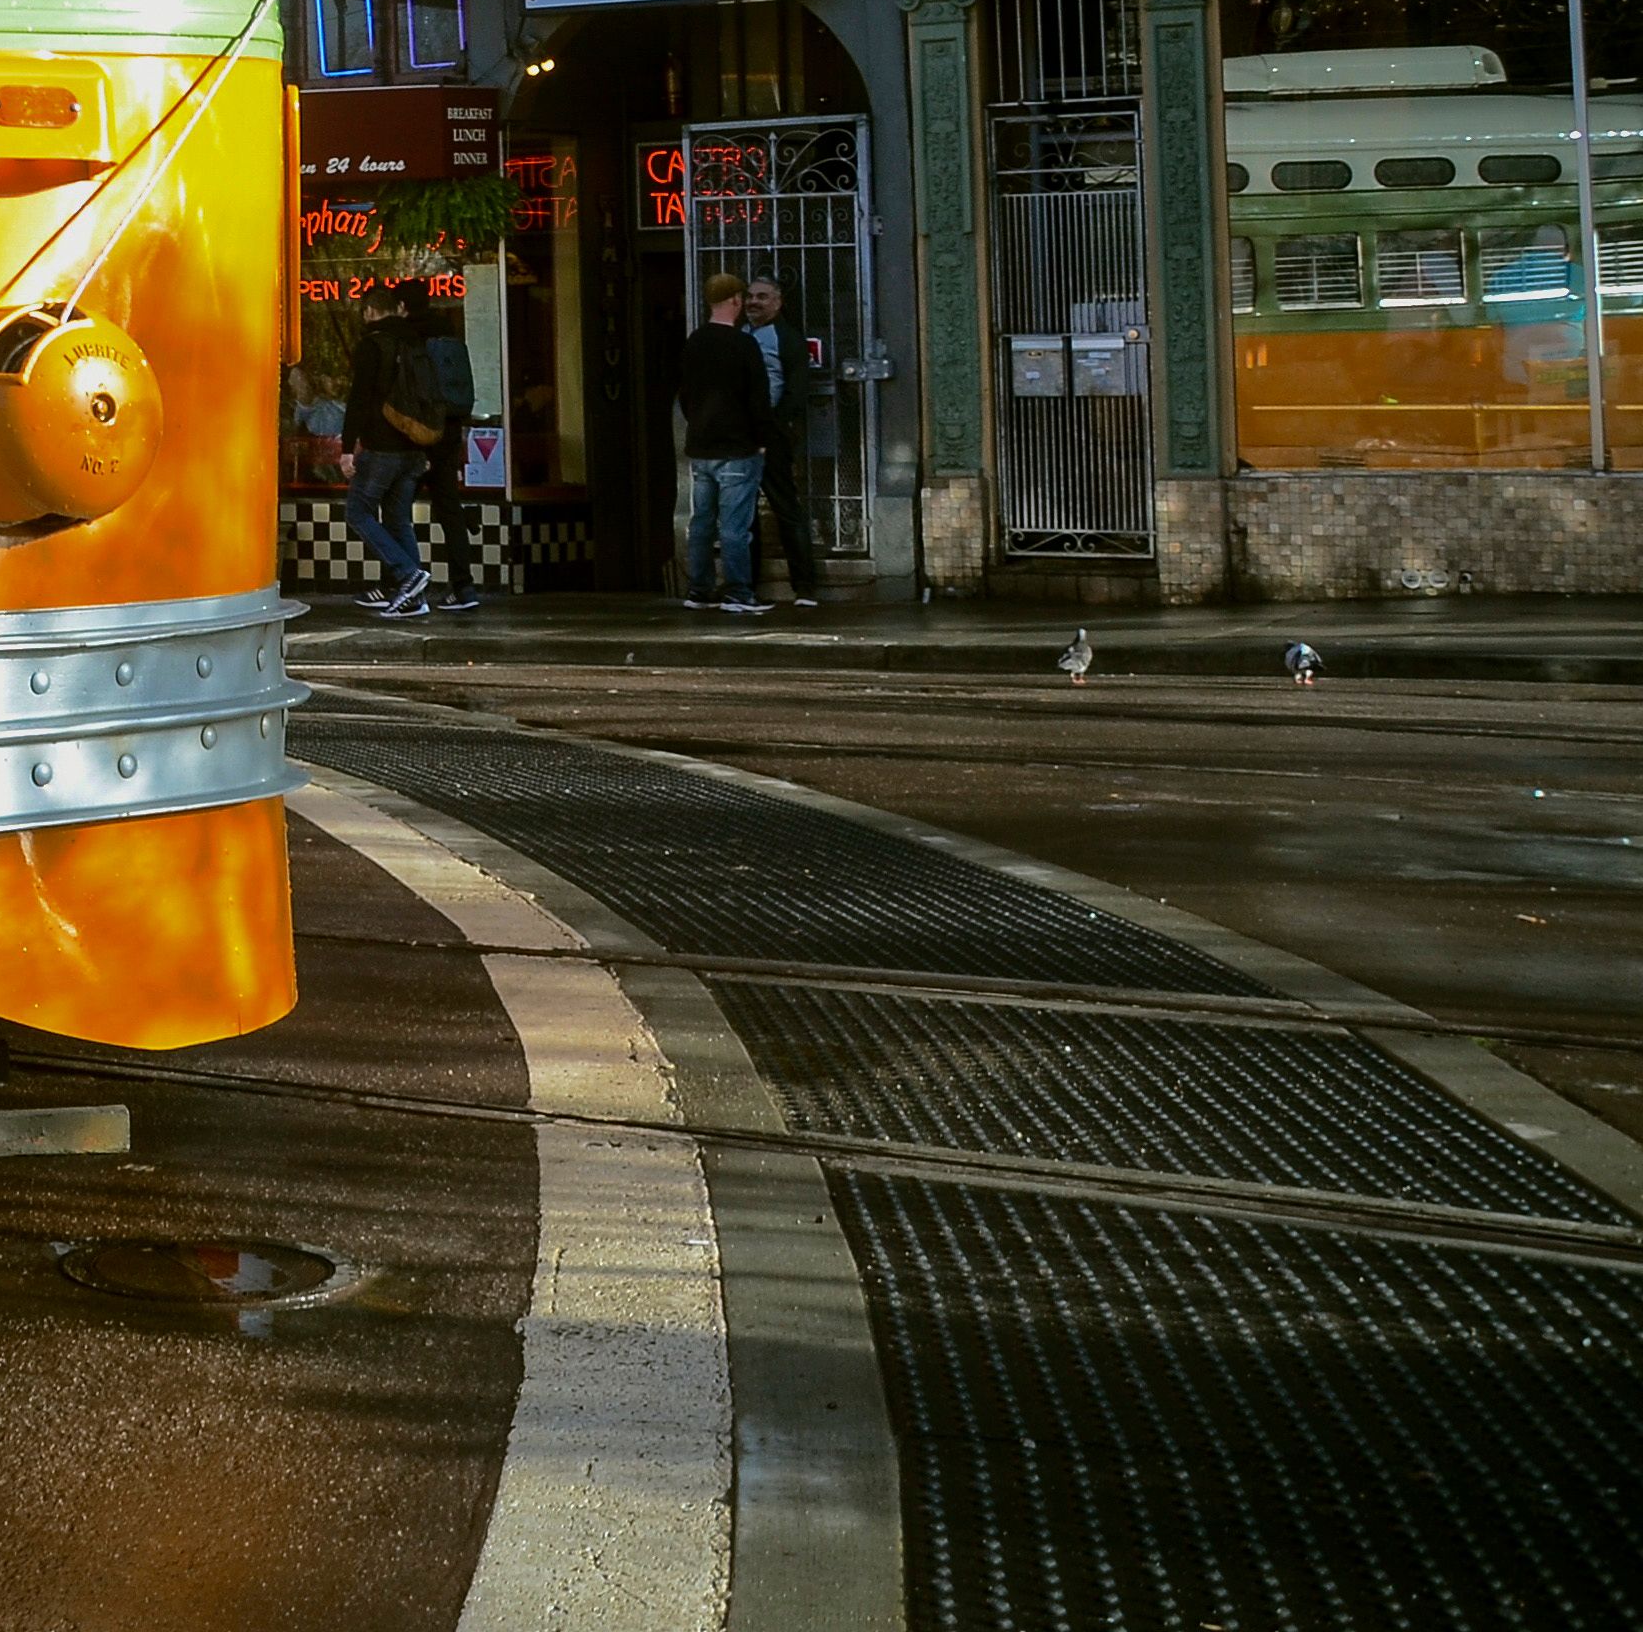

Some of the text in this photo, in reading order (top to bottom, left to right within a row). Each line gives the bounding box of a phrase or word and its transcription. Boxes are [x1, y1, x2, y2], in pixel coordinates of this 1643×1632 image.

[447, 107, 493, 120] BREAKFAST
[453, 129, 486, 142] LUNCH
[300, 155, 406, 174] en 24 hours
[453, 152, 488, 165] DINNER
[300, 279, 340, 301] PEN
